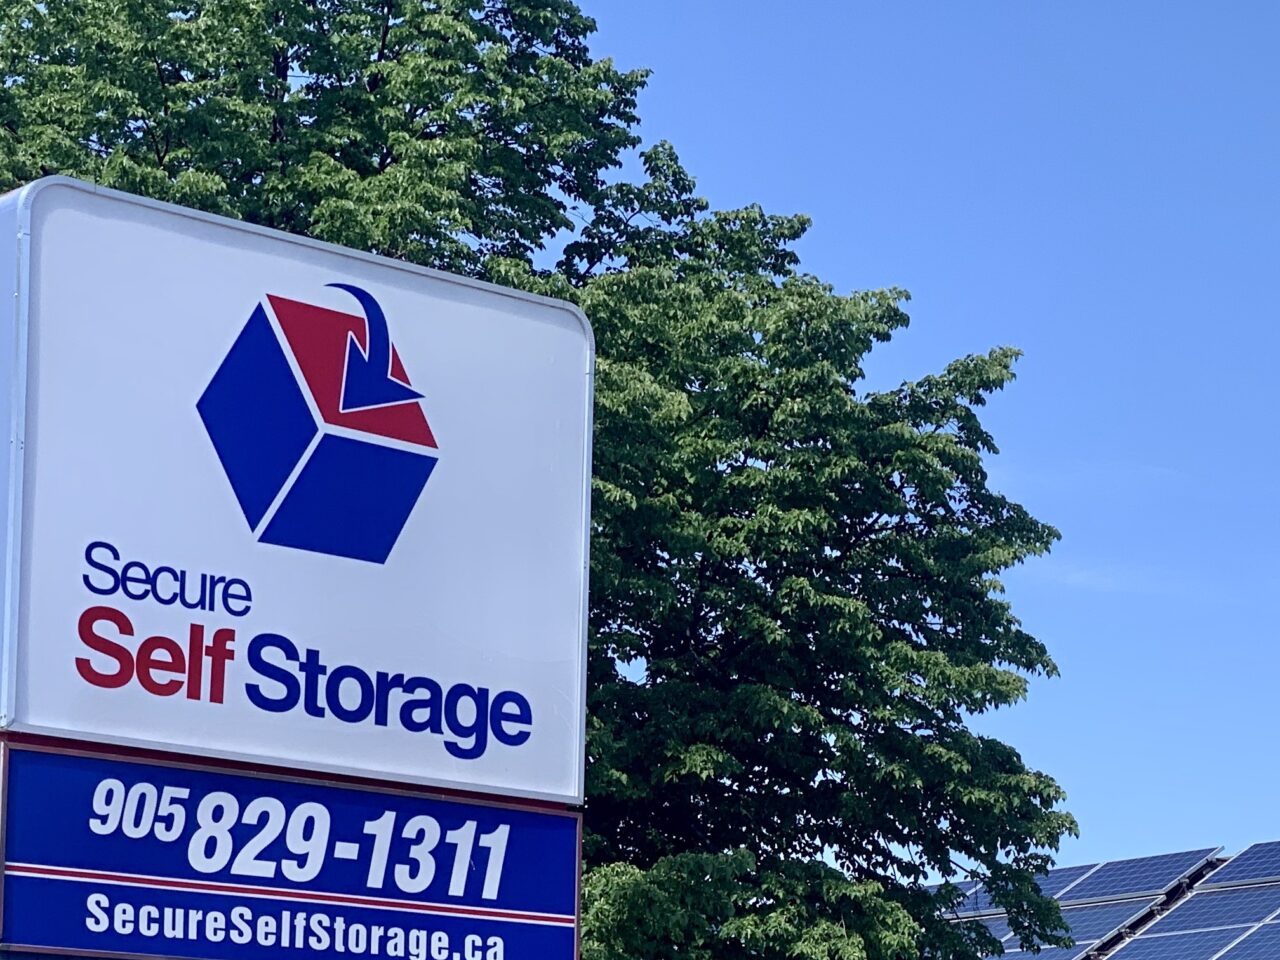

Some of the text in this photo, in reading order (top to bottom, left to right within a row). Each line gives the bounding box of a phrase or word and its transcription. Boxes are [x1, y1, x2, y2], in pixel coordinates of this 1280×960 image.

[82, 541, 253, 617] Secure
[75, 606, 533, 760] Self Storage
[89, 778, 510, 900] 905 829-1311
